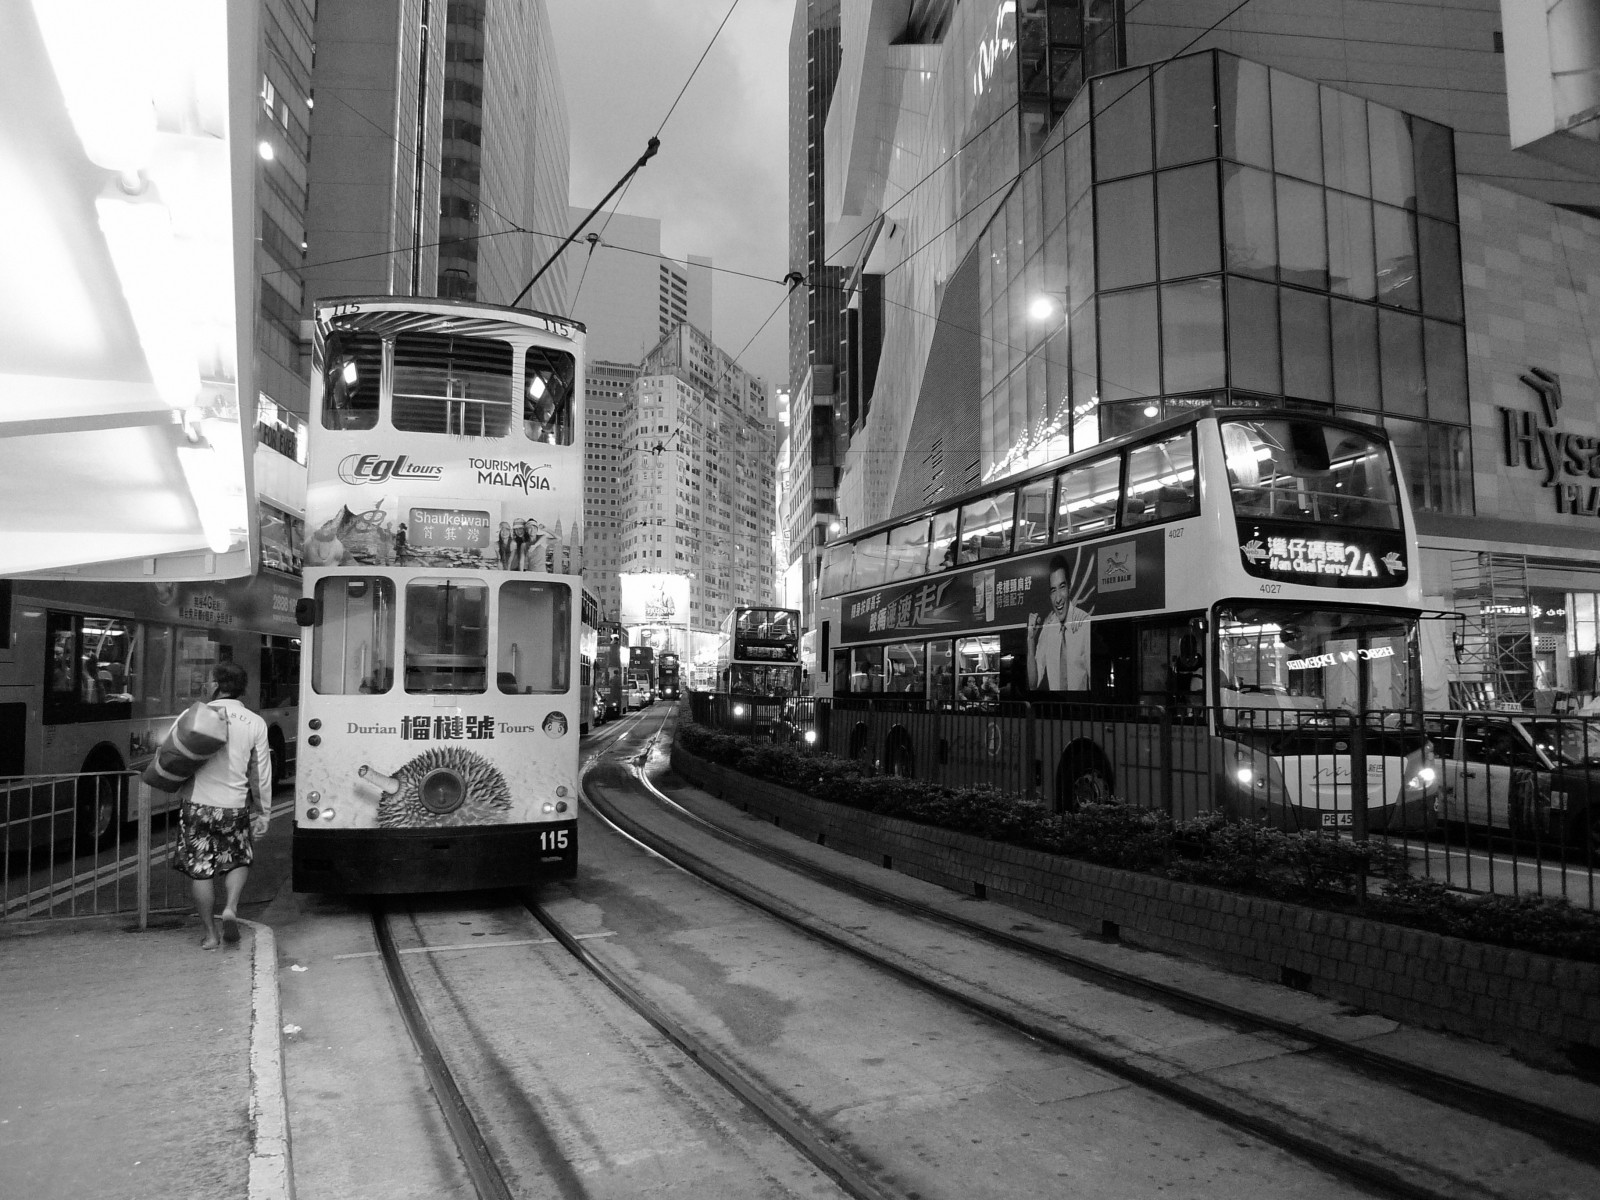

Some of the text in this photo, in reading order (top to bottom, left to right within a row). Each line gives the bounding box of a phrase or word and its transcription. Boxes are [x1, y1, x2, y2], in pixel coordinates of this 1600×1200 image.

[332, 303, 360, 316] 115
[544, 319, 570, 337] 115
[407, 462, 444, 475] tours
[468, 457, 520, 472] TOURISM
[477, 471, 551, 495] MALAYSIA
[414, 510, 489, 527] Shaukeiwan
[1168, 527, 1185, 540] 4027
[1267, 537, 1378, 577] 灣仔碼頭 2A
[1270, 556, 1349, 577] Wan Chai Ferry
[1101, 574, 1132, 585] TIGER BALM
[1259, 584, 1282, 594] 4027
[1507, 703, 1521, 711] TAXI
[346, 722, 398, 735] Durian
[497, 722, 535, 734] Tours
[540, 829, 569, 851] 115
